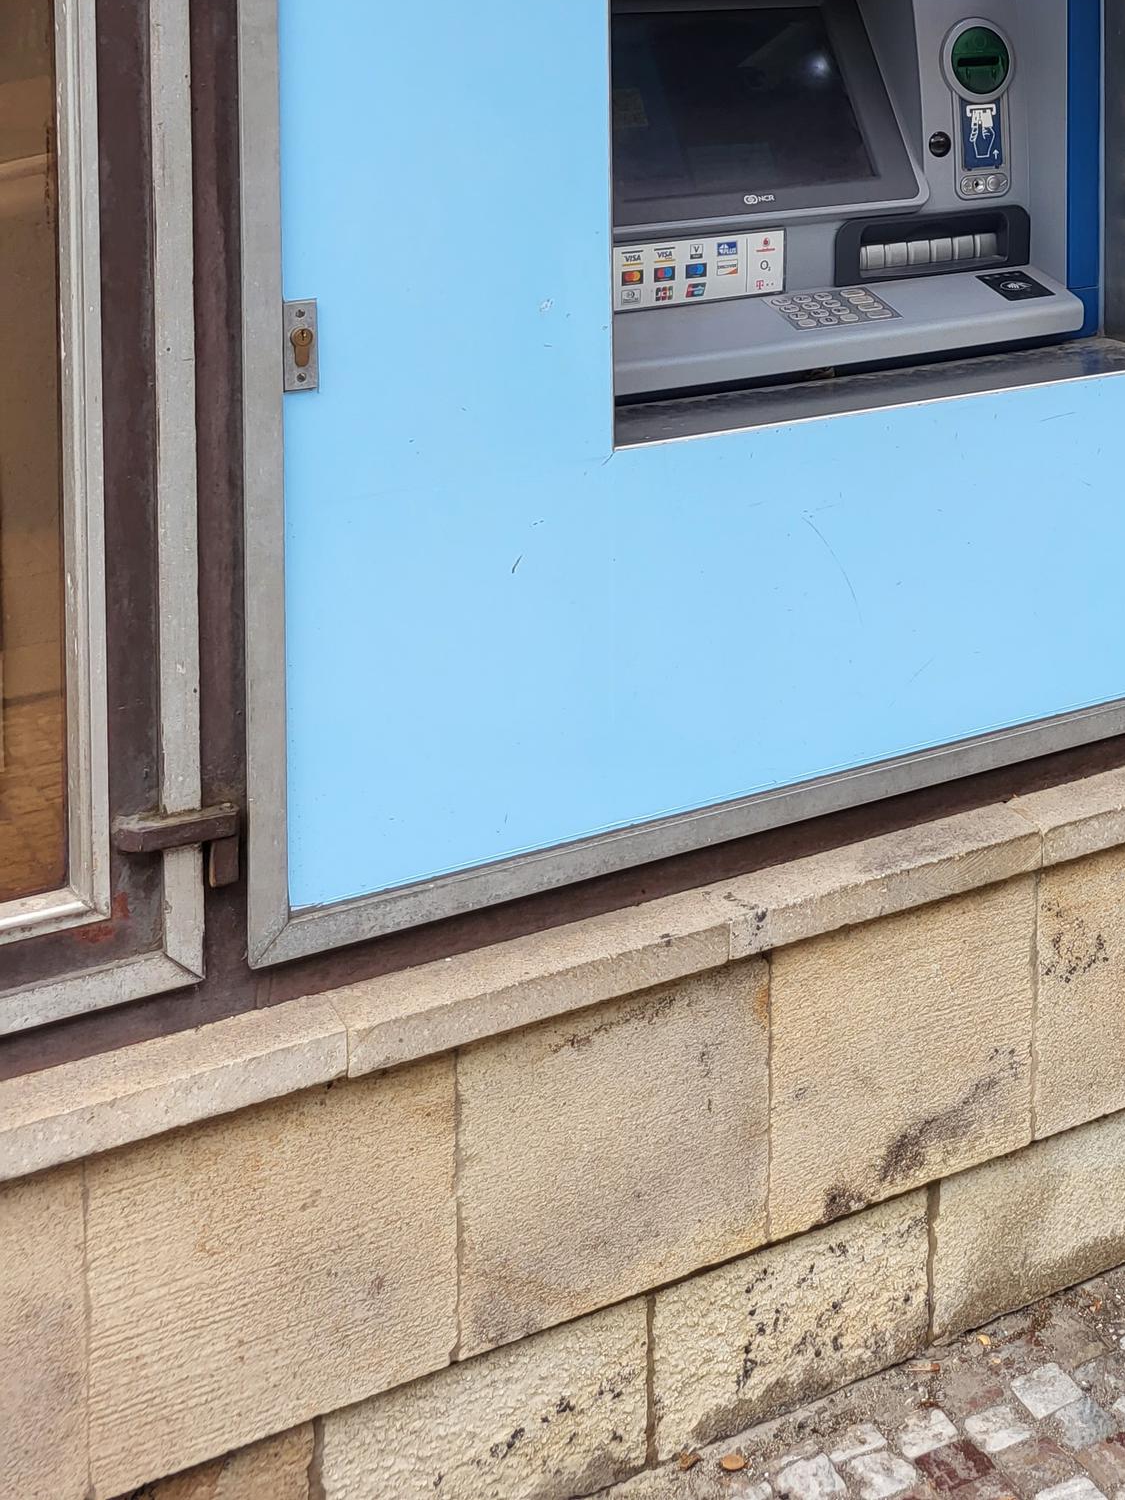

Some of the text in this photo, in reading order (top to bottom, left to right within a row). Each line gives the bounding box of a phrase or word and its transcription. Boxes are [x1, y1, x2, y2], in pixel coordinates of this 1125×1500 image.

[758, 194, 775, 202] NCR
[623, 254, 641, 263] VISA
[656, 250, 673, 259] VISA
